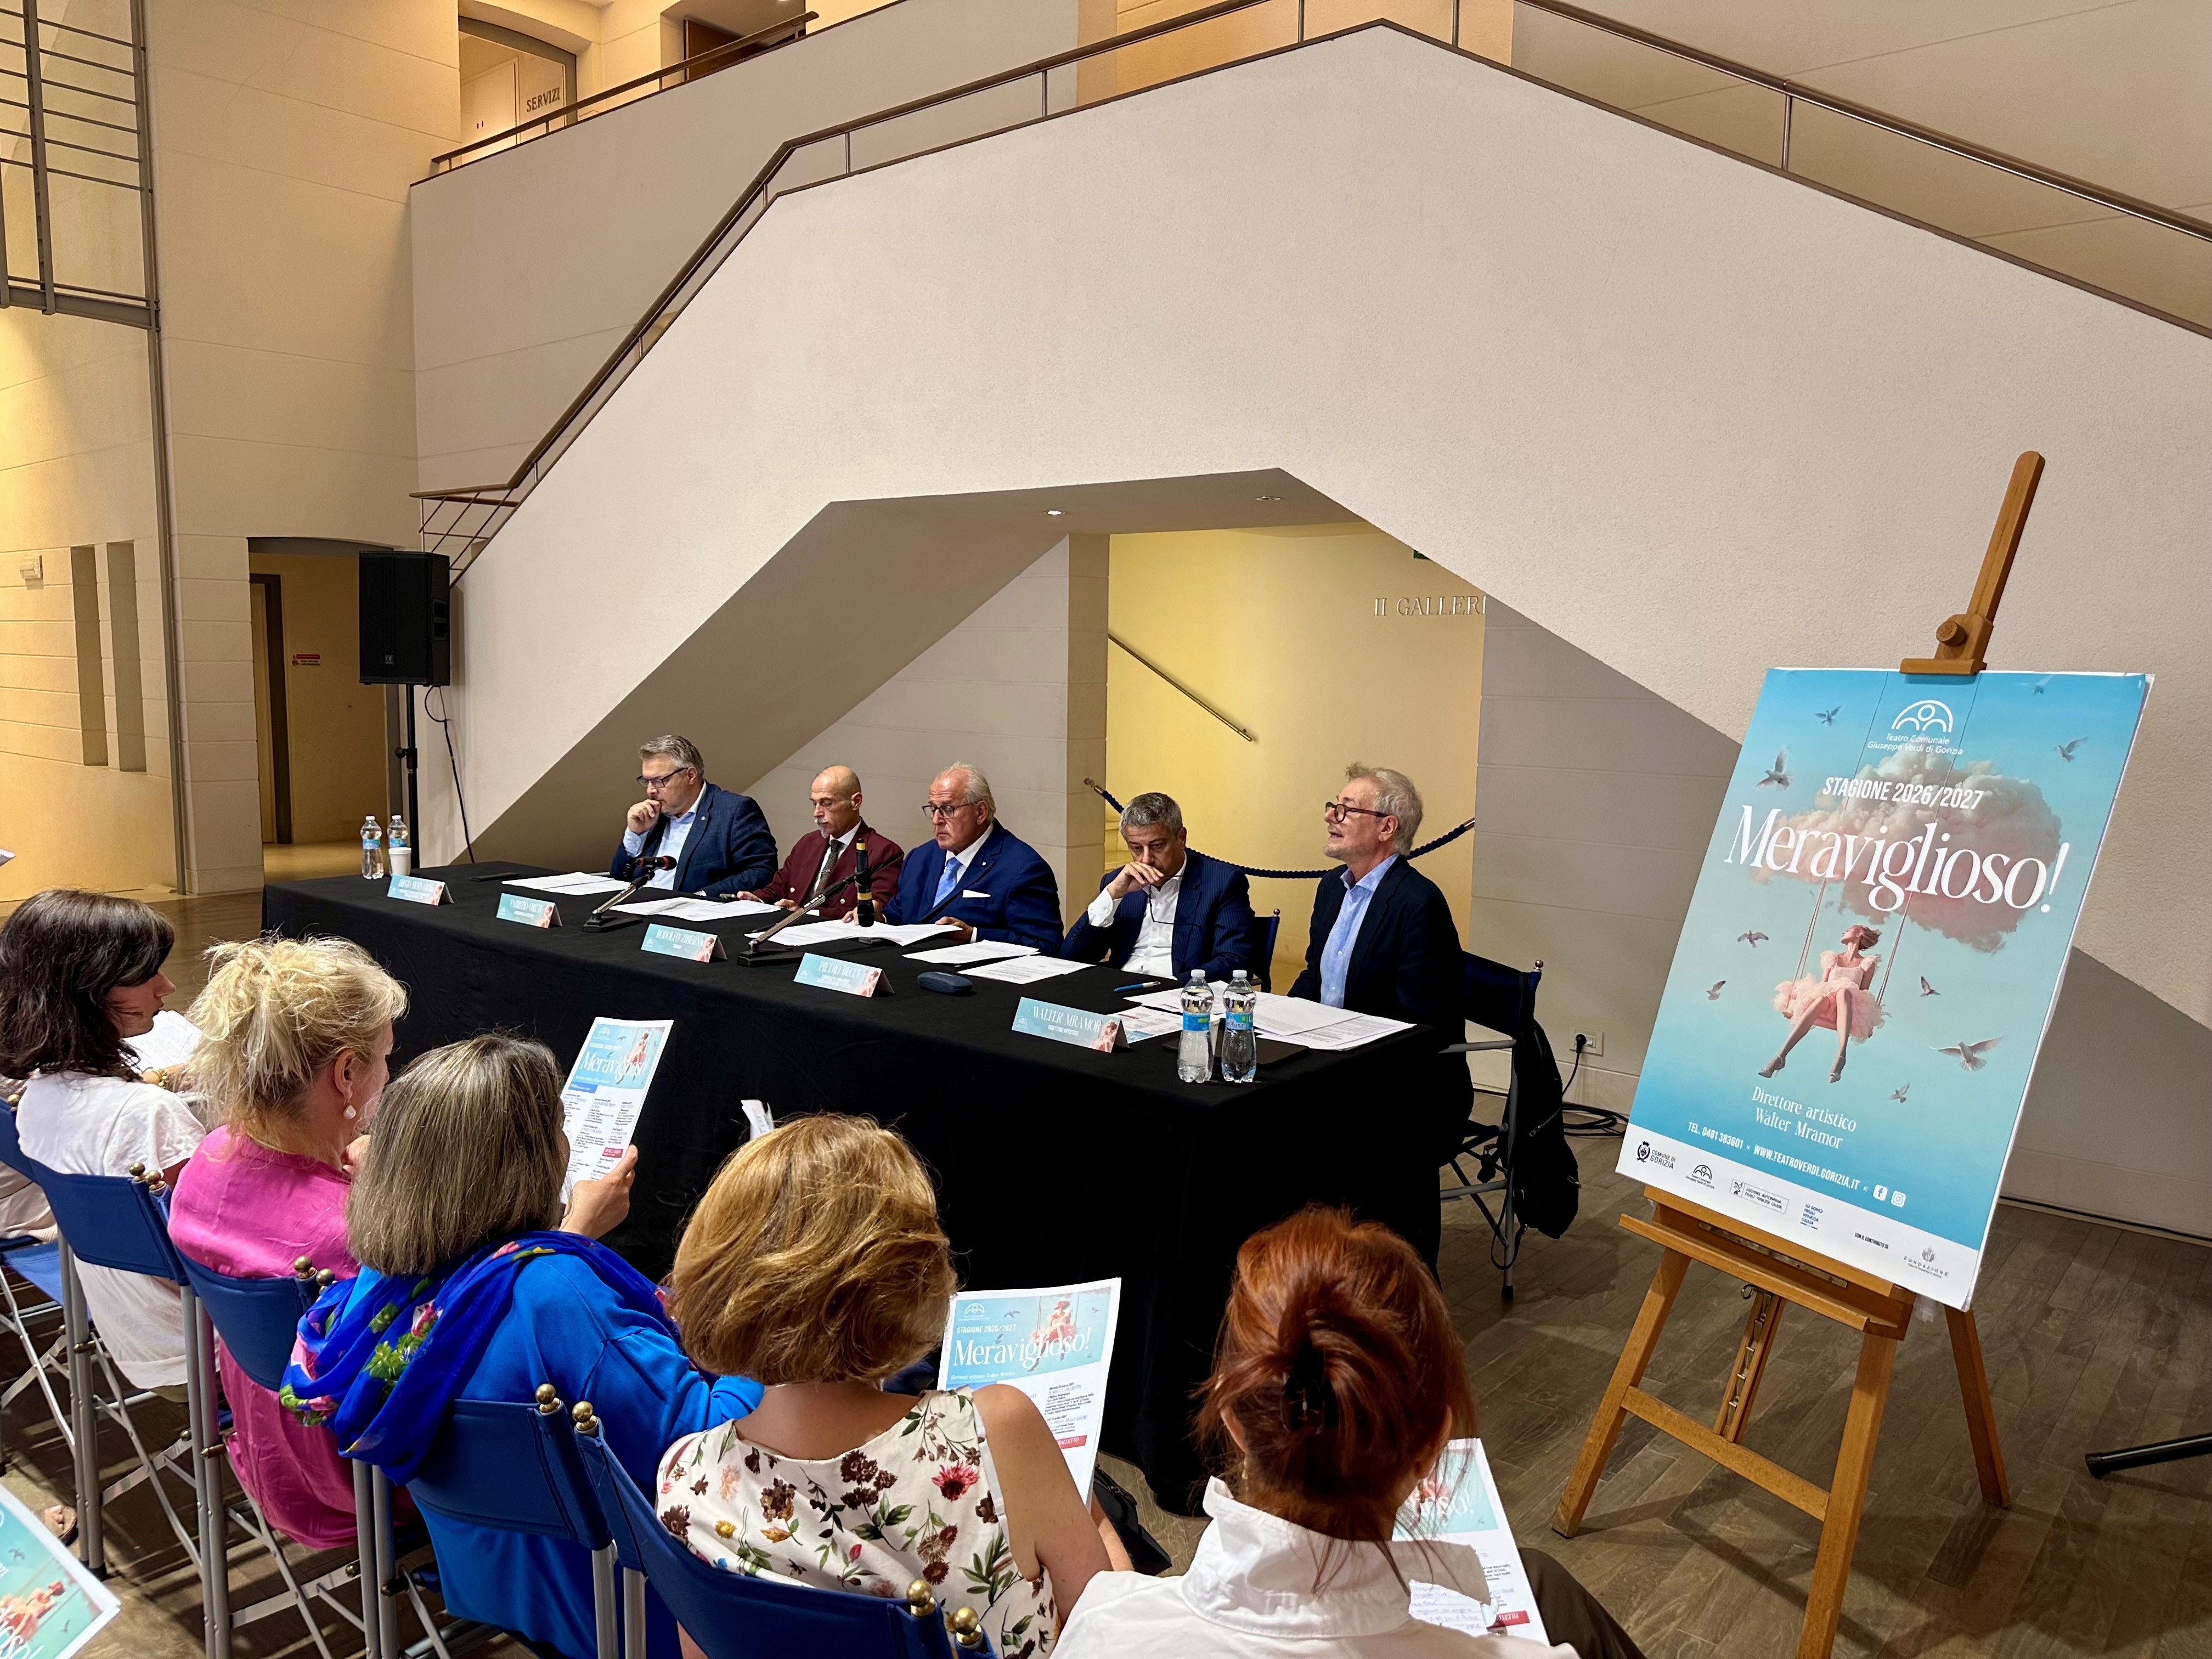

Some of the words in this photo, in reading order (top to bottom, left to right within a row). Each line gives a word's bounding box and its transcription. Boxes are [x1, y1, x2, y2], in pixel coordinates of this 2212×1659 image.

[527, 87, 560, 112] SERVIZI
[1374, 597, 1387, 616] II
[1867, 741, 1902, 751] Giuseppe
[1905, 743, 1923, 753] Verdi
[1936, 746, 1963, 755] Gorizia
[1887, 733, 1909, 742] Teatro
[1910, 735, 1950, 745] Comunale
[1822, 776, 1892, 800] STAGIONE
[1892, 782, 1984, 809] 2026/2027
[1724, 804, 2070, 913] Meraviglioso!
[818, 961, 841, 975] PIETRO
[841, 966, 861, 979] BECCI
[1033, 1006, 1063, 1024] WALTER
[1065, 1013, 1102, 1032] MRAMOR
[1752, 1086, 1802, 1115] Direttore
[1806, 1106, 1857, 1132] artistico
[1756, 1107, 1791, 1132] Walter
[1795, 1120, 1843, 1149] Mramor
[1650, 1155, 1673, 1169] GORIZIA
[1651, 1149, 1670, 1160] COMUNE
[1688, 1121, 1700, 1135] TEL.
[1702, 1127, 1718, 1141] 0481
[1718, 1132, 1743, 1149] 383601
[1753, 1144, 1860, 1190] WWW.TEATROVERDI.GORIZIA.IT
[1904, 1256, 1949, 1277] FONDAZIONE
[956, 1325, 983, 1334] STAGIONE
[984, 1324, 1017, 1333] 2026/2027
[952, 1327, 1091, 1369] Meraviglioso!
